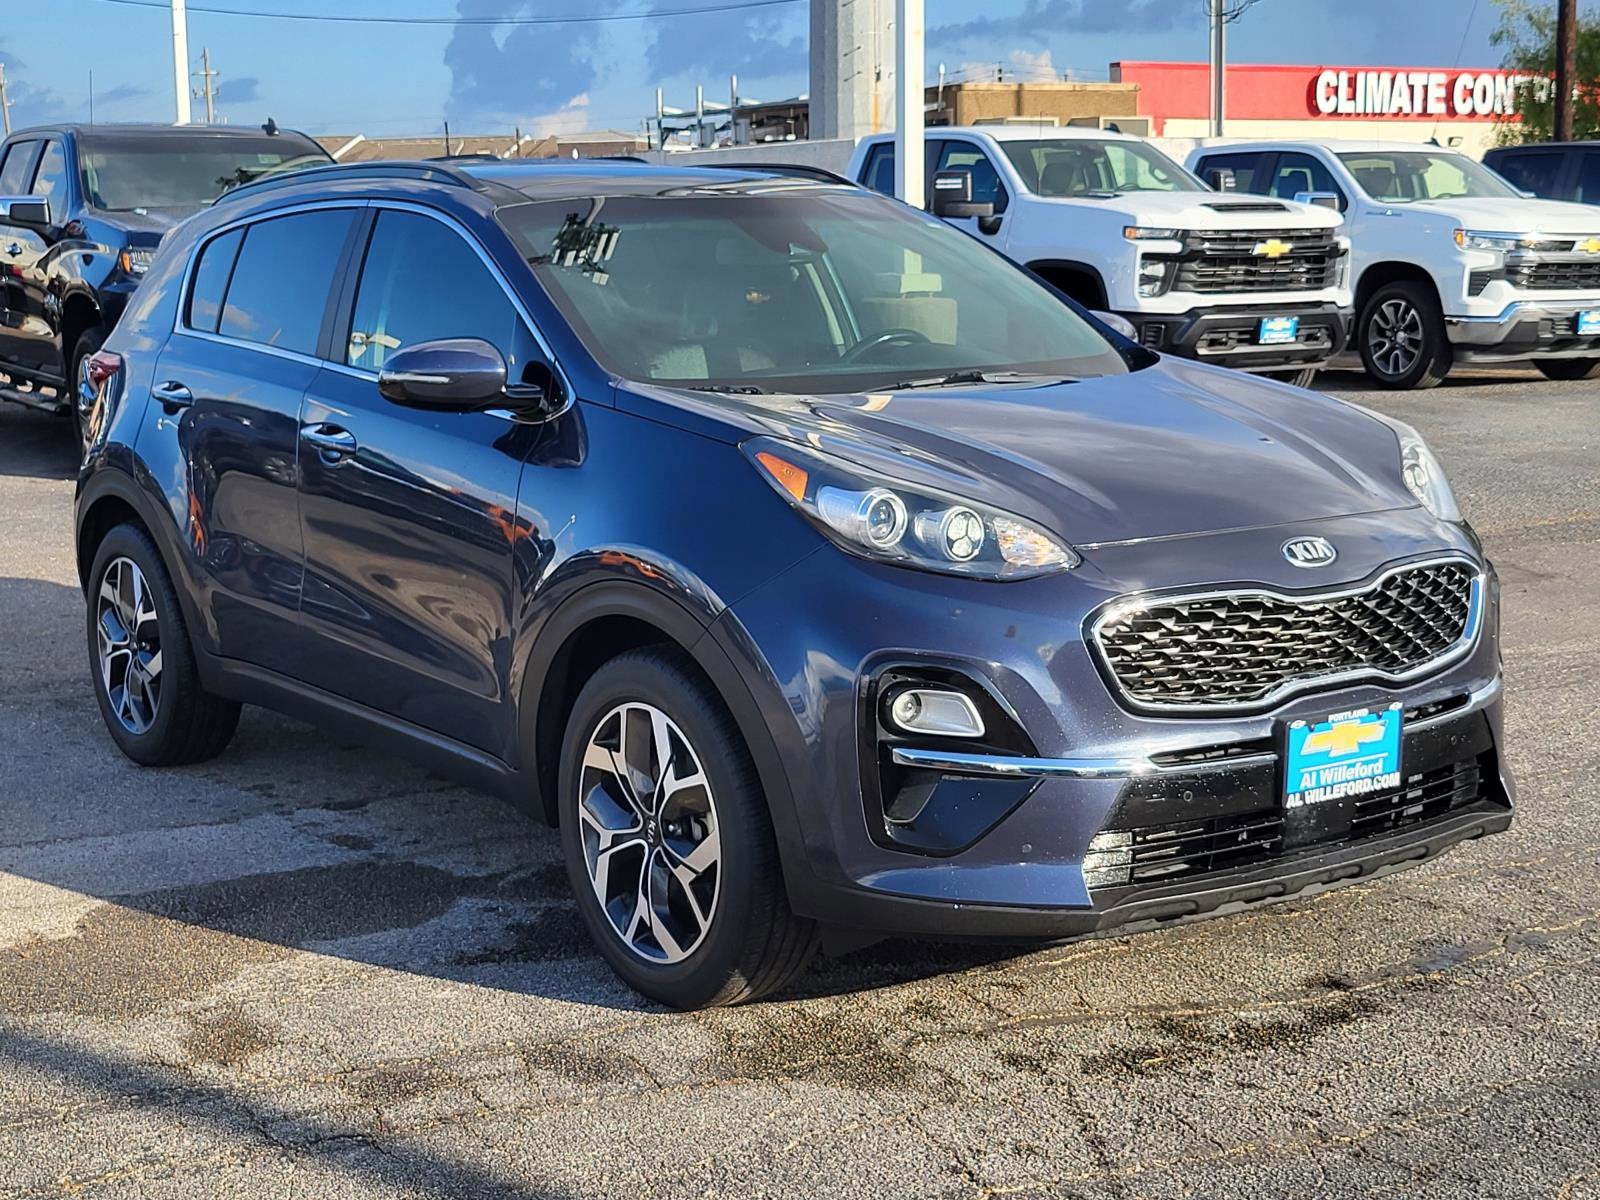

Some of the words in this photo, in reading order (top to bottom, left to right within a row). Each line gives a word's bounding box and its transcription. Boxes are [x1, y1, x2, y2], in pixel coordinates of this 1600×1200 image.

[1315, 69, 1447, 115] CLIMATE
[1453, 72, 1581, 115] CONTR
[1288, 541, 1332, 560] KIA
[1328, 708, 1369, 722] PORTLAND
[1300, 771, 1317, 789] Al
[1320, 758, 1384, 785] Willeford
[1286, 792, 1304, 809] AL
[1305, 771, 1401, 804] WILLEFORD.COM
[647, 819, 657, 844] KIA
